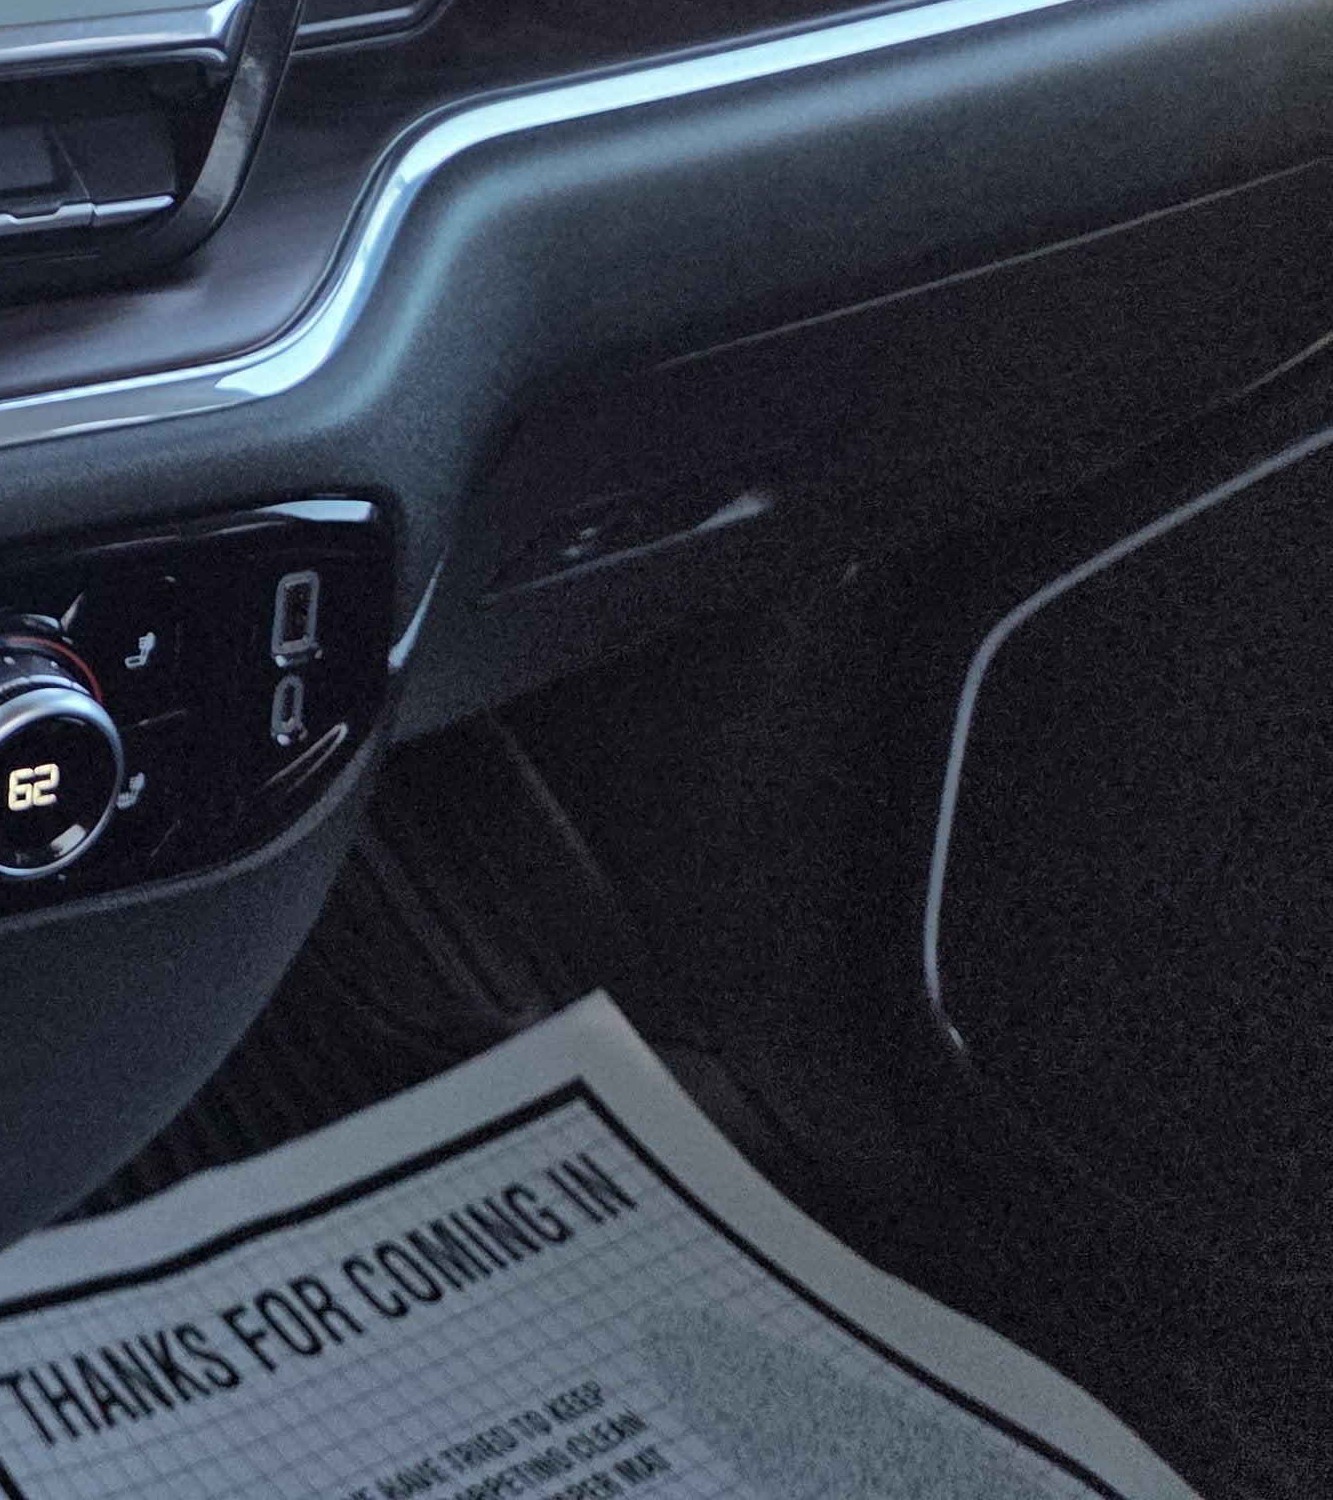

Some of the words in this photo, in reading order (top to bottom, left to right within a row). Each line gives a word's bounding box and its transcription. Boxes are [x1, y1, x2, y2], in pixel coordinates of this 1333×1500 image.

[8, 763, 60, 811] 62
[220, 1274, 364, 1372] FOR
[341, 1181, 574, 1319] COMING
[546, 1151, 637, 1224] IN
